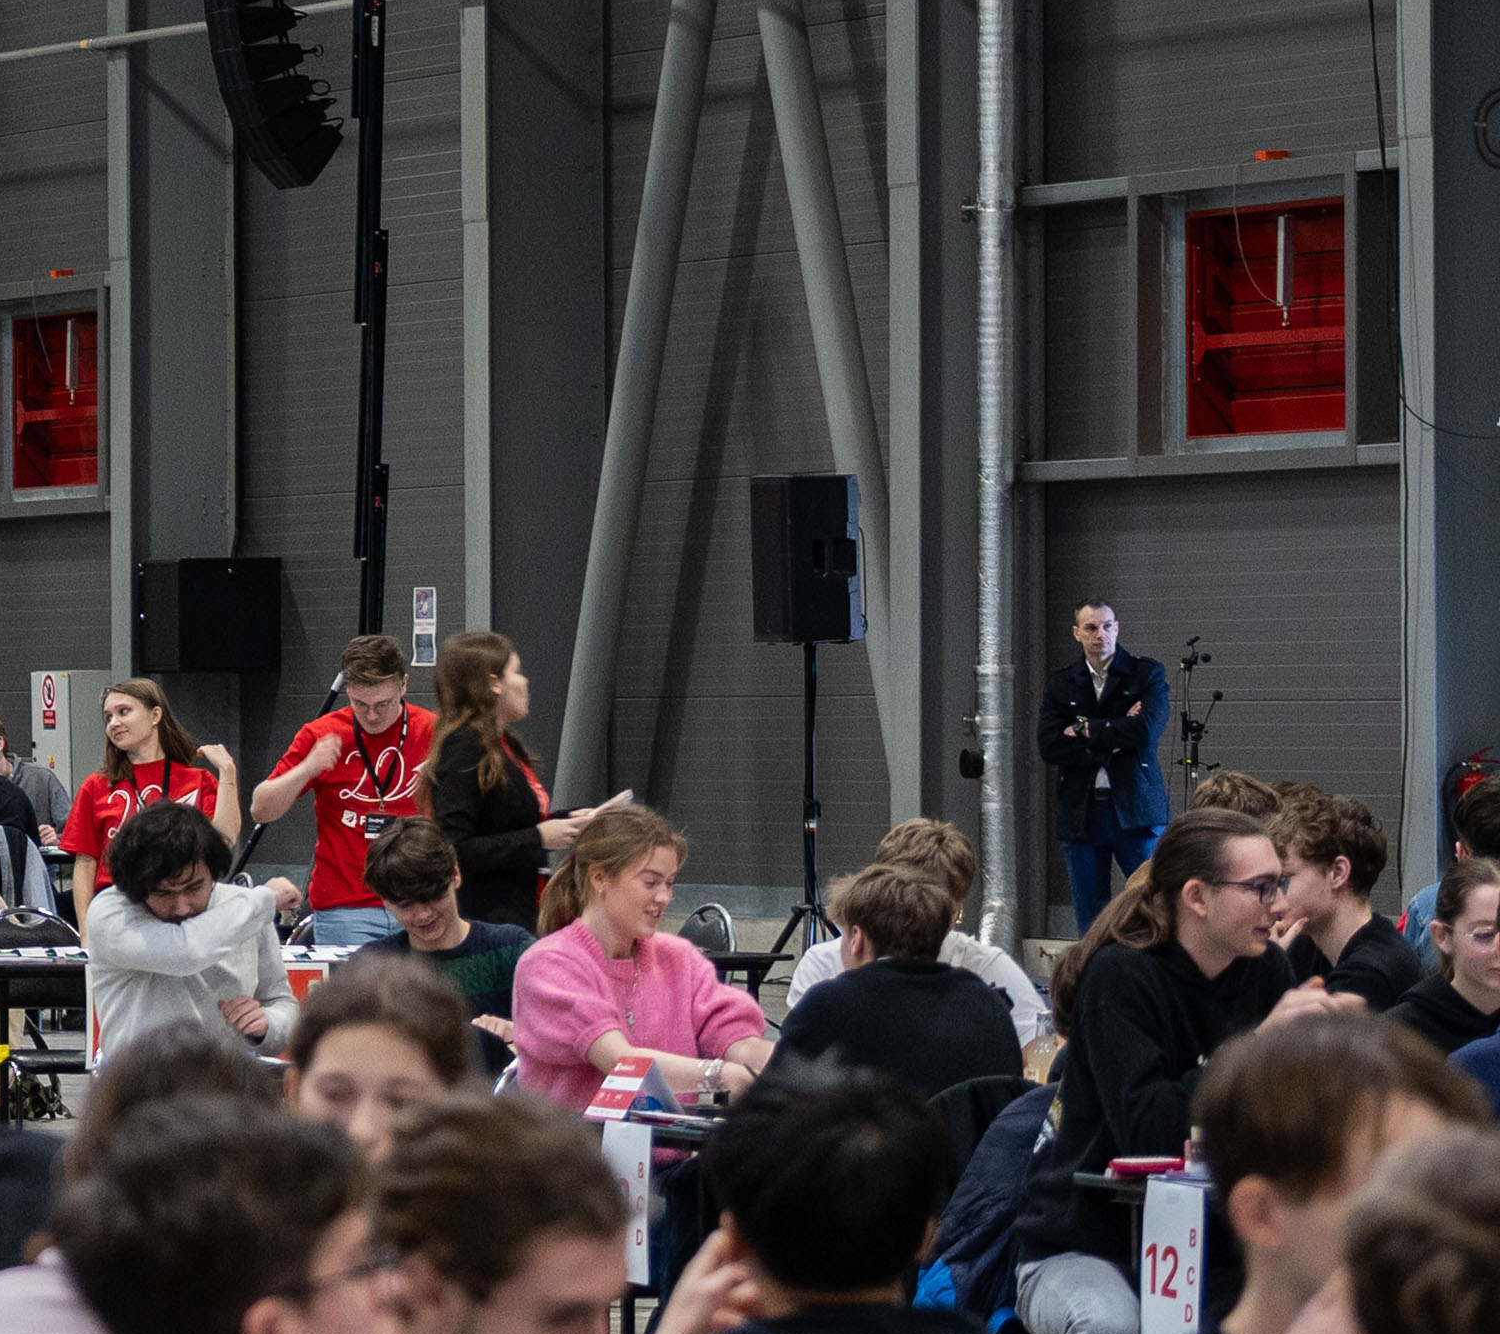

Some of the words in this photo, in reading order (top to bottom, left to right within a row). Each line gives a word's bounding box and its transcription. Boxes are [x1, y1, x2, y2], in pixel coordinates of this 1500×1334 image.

[638, 1162, 645, 1178] B
[1189, 1228, 1197, 1248] B
[1145, 1243, 1179, 1299] 12
[1186, 1267, 1195, 1285] C
[1184, 1304, 1193, 1323] D
